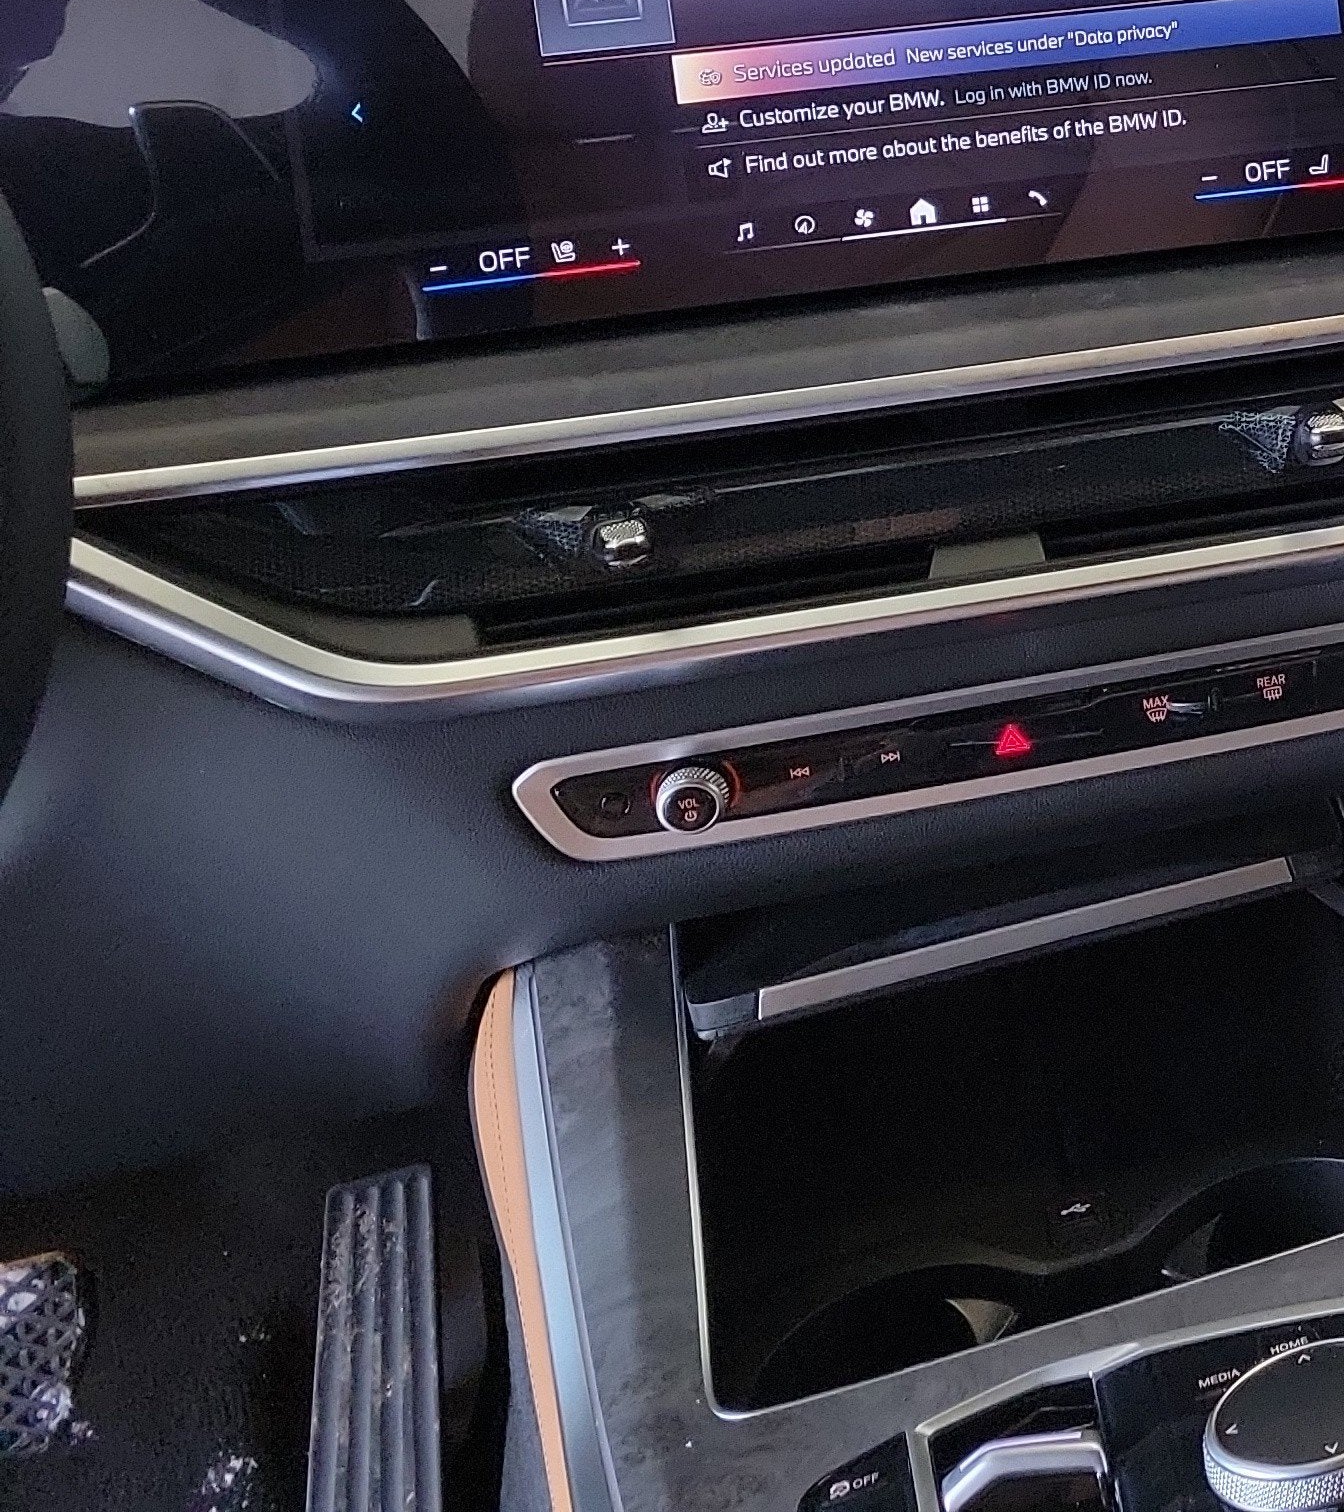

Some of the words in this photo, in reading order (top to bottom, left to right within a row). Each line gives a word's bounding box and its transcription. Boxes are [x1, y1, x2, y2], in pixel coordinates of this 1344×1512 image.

[733, 59, 813, 84] Services
[818, 48, 896, 76] updated
[906, 46, 944, 65] New
[948, 40, 1013, 61] services
[1017, 34, 1064, 56] under
[1068, 31, 1114, 49] "Data
[1116, 21, 1179, 47] privacy"
[739, 101, 839, 129] Customize
[843, 98, 886, 123] your
[889, 89, 945, 112] BMW.
[955, 86, 986, 109] Log
[990, 84, 1005, 102] in
[1009, 82, 1042, 99] with
[1046, 76, 1090, 96] BMW
[1093, 73, 1111, 91] ID
[1115, 71, 1153, 88] now.
[745, 152, 789, 175] Find
[793, 150, 824, 170] out
[829, 145, 878, 166] more
[882, 136, 937, 162] about
[941, 132, 972, 154] the
[975, 123, 1048, 149] benefits
[1053, 121, 1072, 140] of
[1075, 118, 1105, 138] the
[1108, 111, 1158, 134] BMW
[1162, 108, 1188, 129] ID.
[1244, 160, 1290, 184] OFF
[478, 246, 531, 274] OFF
[1256, 673, 1286, 689] REAR
[1142, 694, 1169, 711] MAX
[677, 798, 700, 810] VOL
[1198, 1368, 1241, 1390] MEDIA
[1270, 1335, 1309, 1356] HOME
[852, 1471, 880, 1490] OFF
